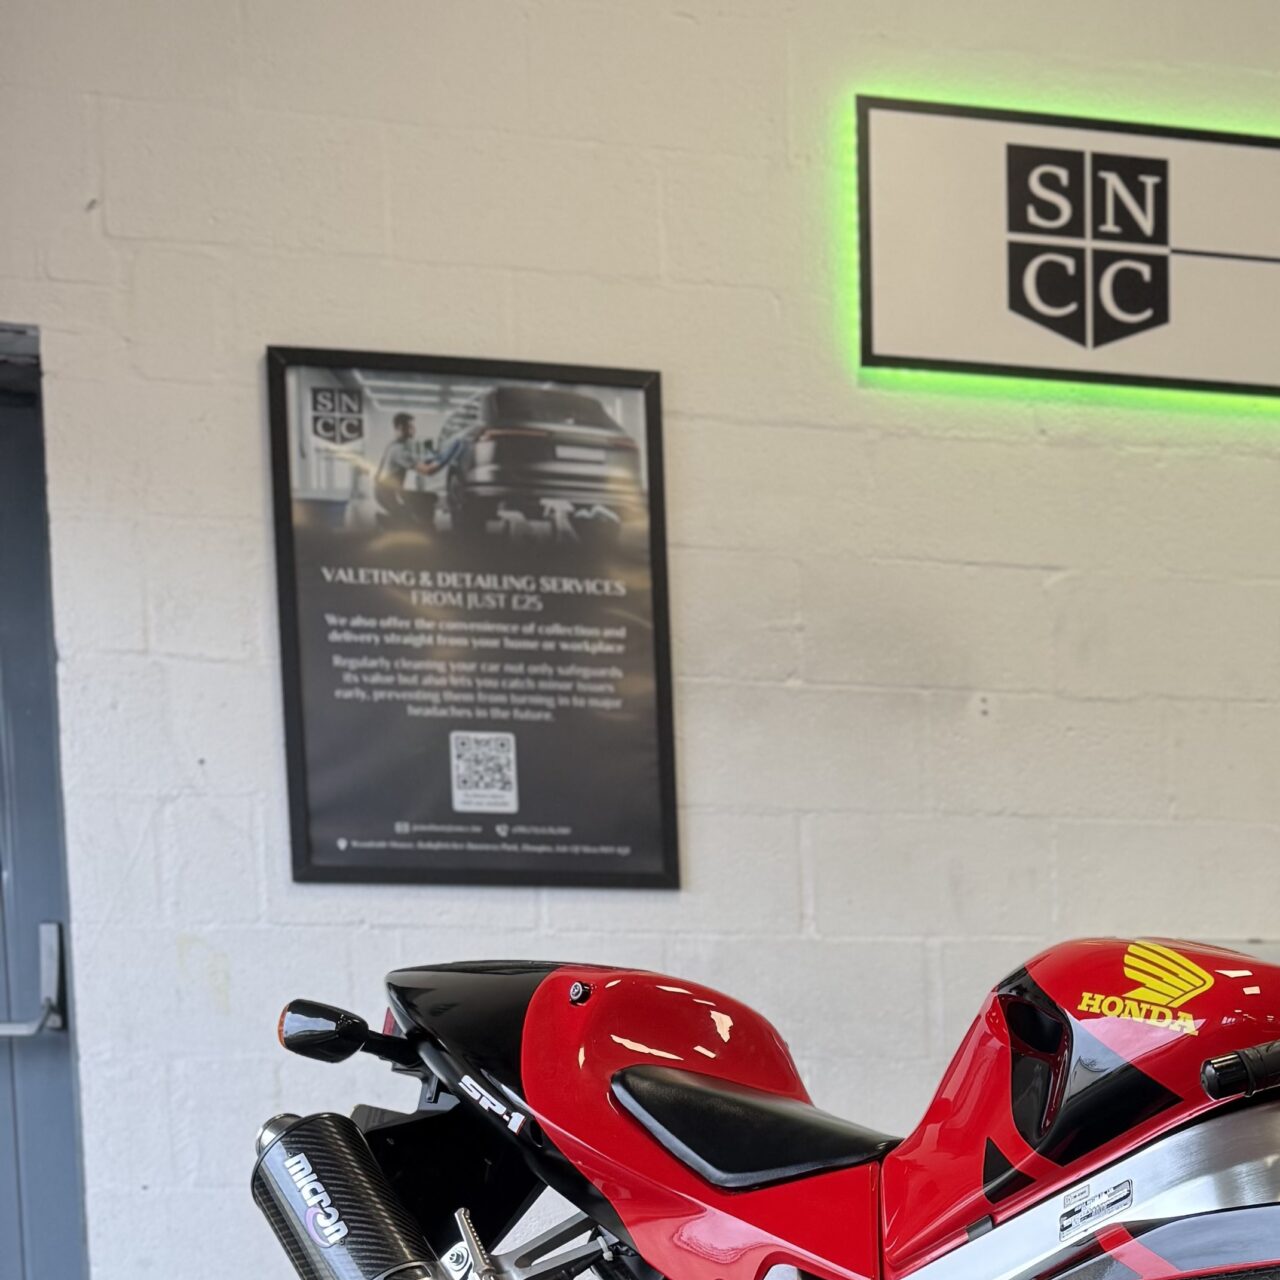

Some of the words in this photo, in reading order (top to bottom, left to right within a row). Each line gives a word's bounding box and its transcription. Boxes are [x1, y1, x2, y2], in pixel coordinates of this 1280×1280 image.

[321, 566, 415, 587] VALETING
[420, 572, 432, 587] &
[438, 573, 536, 592] DETAILING
[540, 579, 627, 597] SERVICES
[411, 590, 463, 606] FROM
[467, 593, 505, 610] JUST
[512, 596, 543, 612] £25
[1077, 990, 1200, 1036] HONDA
